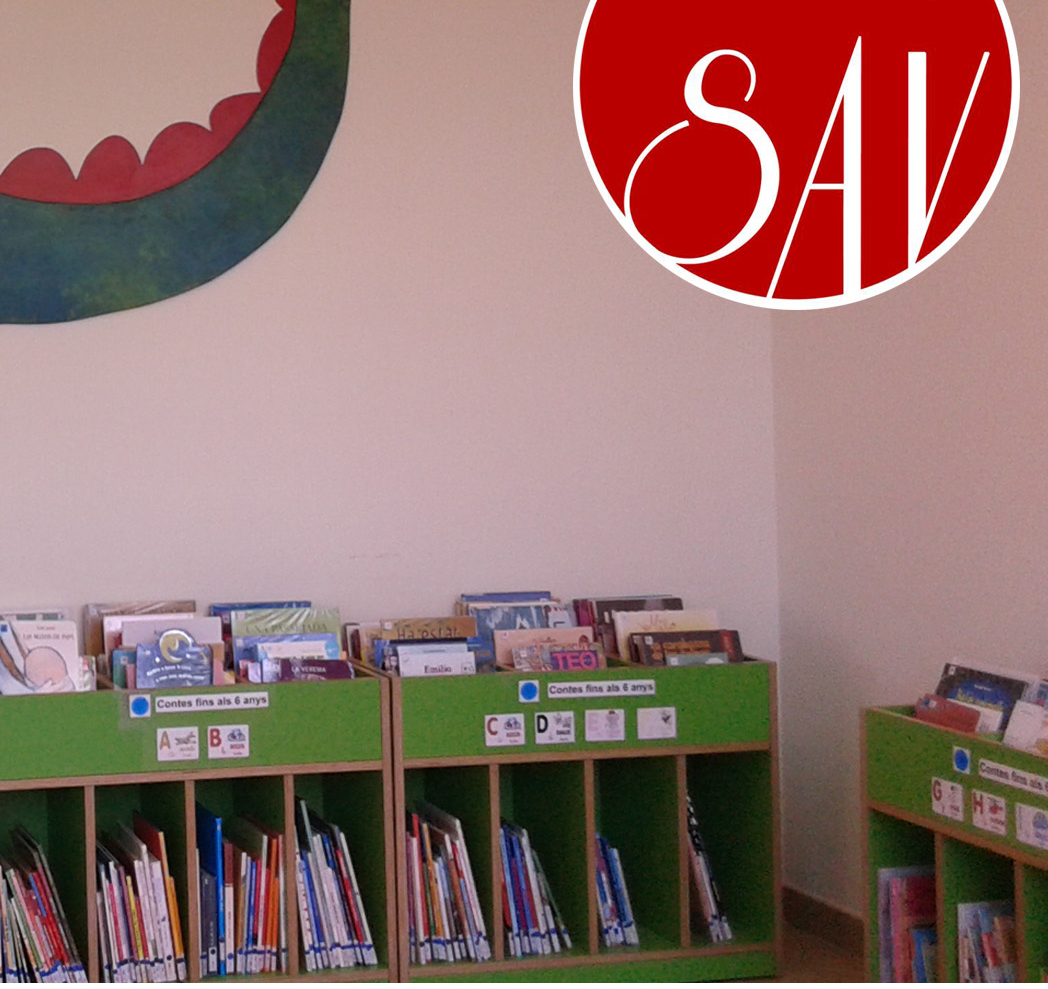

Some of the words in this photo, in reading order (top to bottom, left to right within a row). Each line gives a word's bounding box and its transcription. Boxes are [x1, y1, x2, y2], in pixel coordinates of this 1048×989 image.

[553, 652, 597, 670] TEO
[549, 685, 583, 695] Contes
[586, 683, 603, 693] fins
[606, 683, 620, 693] als
[623, 683, 629, 692] 6
[631, 683, 654, 693] anys
[157, 699, 192, 709] Contes
[195, 697, 214, 707] fins
[217, 696, 232, 706] als
[234, 695, 241, 705] 6
[243, 695, 267, 706] anys
[486, 717, 498, 736] C
[536, 714, 548, 734] D
[159, 730, 171, 750] A
[209, 728, 222, 748] B
[979, 761, 1009, 780] Contes
[1011, 771, 1028, 786] fins
[932, 779, 942, 802] G
[972, 791, 984, 815] H
